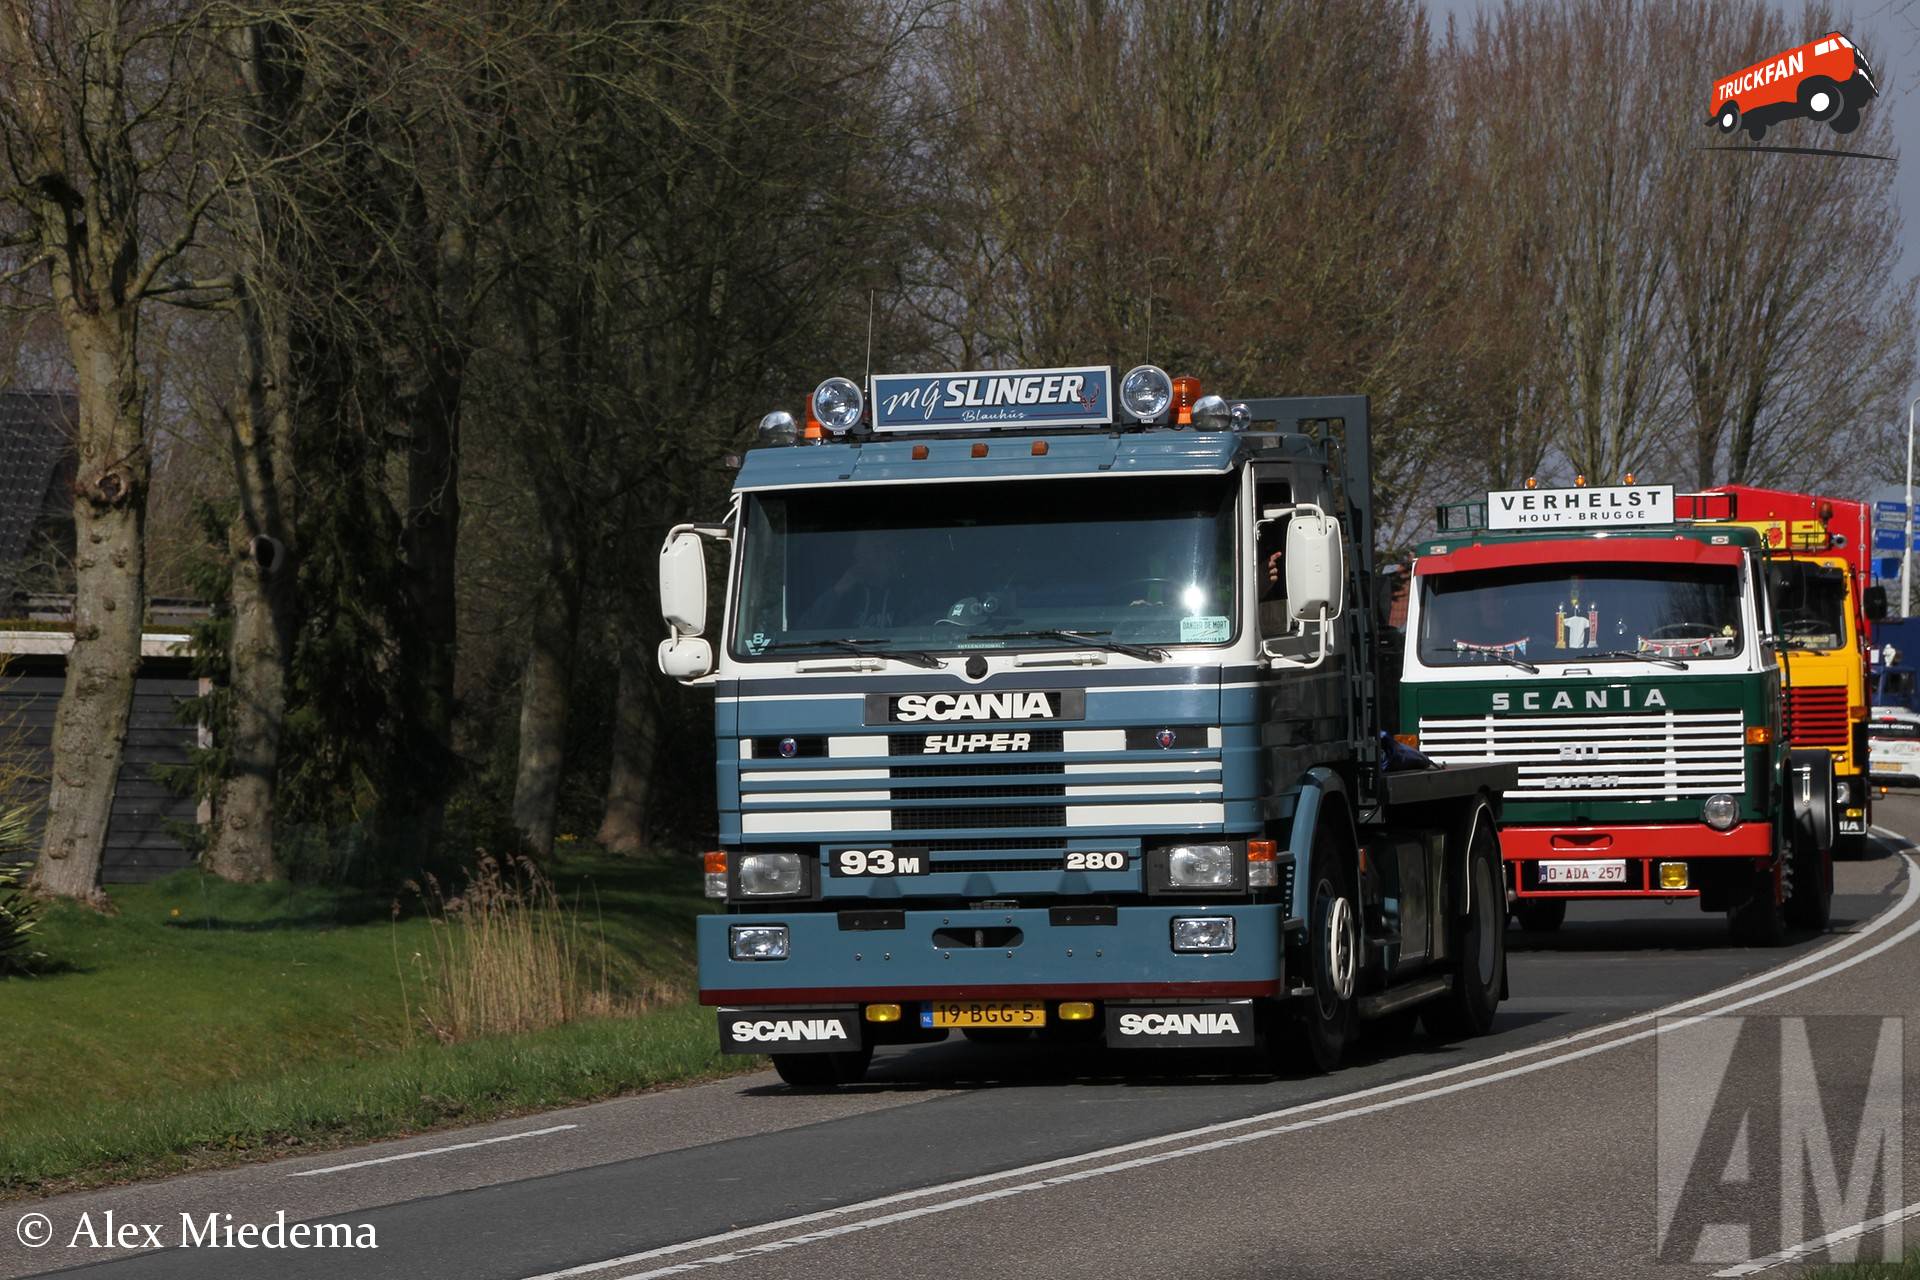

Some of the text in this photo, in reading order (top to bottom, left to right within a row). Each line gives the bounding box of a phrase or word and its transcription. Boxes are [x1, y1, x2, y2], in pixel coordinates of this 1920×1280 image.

[943, 375, 1085, 407] SLINGER
[1500, 491, 1661, 511] VERHELST
[1518, 513, 1562, 523] HOUT
[1579, 510, 1646, 521] BRUGGE
[896, 692, 1055, 722] SCANIA
[1492, 688, 1667, 711] SCANIA
[922, 733, 1031, 754] SUPER
[1559, 743, 1599, 761] 80
[1543, 775, 1620, 789] SUPER
[1066, 852, 1124, 870] 280
[940, 1003, 1035, 1024] 19-BGG-5
[1119, 1013, 1240, 1035] SCANIA
[731, 1019, 848, 1042] SCANIA
